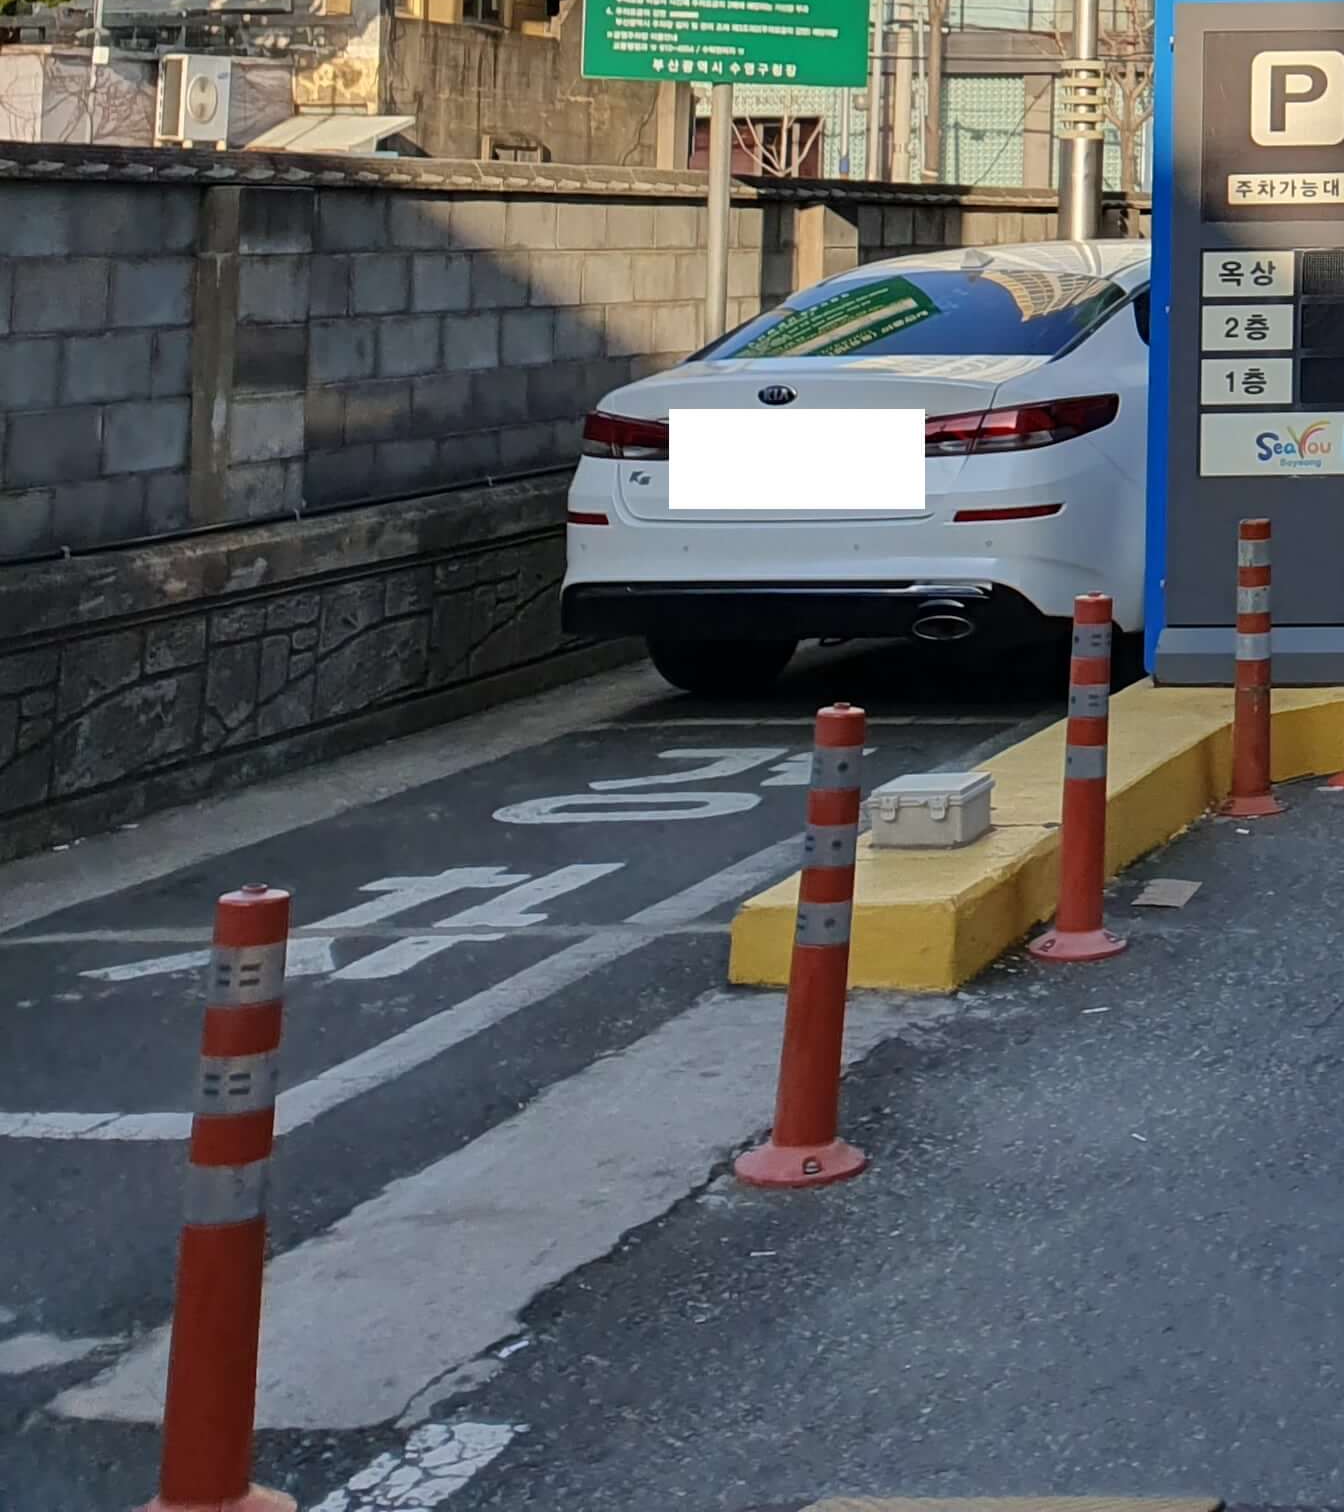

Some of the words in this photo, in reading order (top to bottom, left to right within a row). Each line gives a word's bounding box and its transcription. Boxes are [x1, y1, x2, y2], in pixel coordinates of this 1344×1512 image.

[1270, 65, 1329, 132] P
[1219, 261, 1276, 287] 옥상
[1225, 314, 1269, 341] 2층
[1225, 368, 1267, 395] 1층
